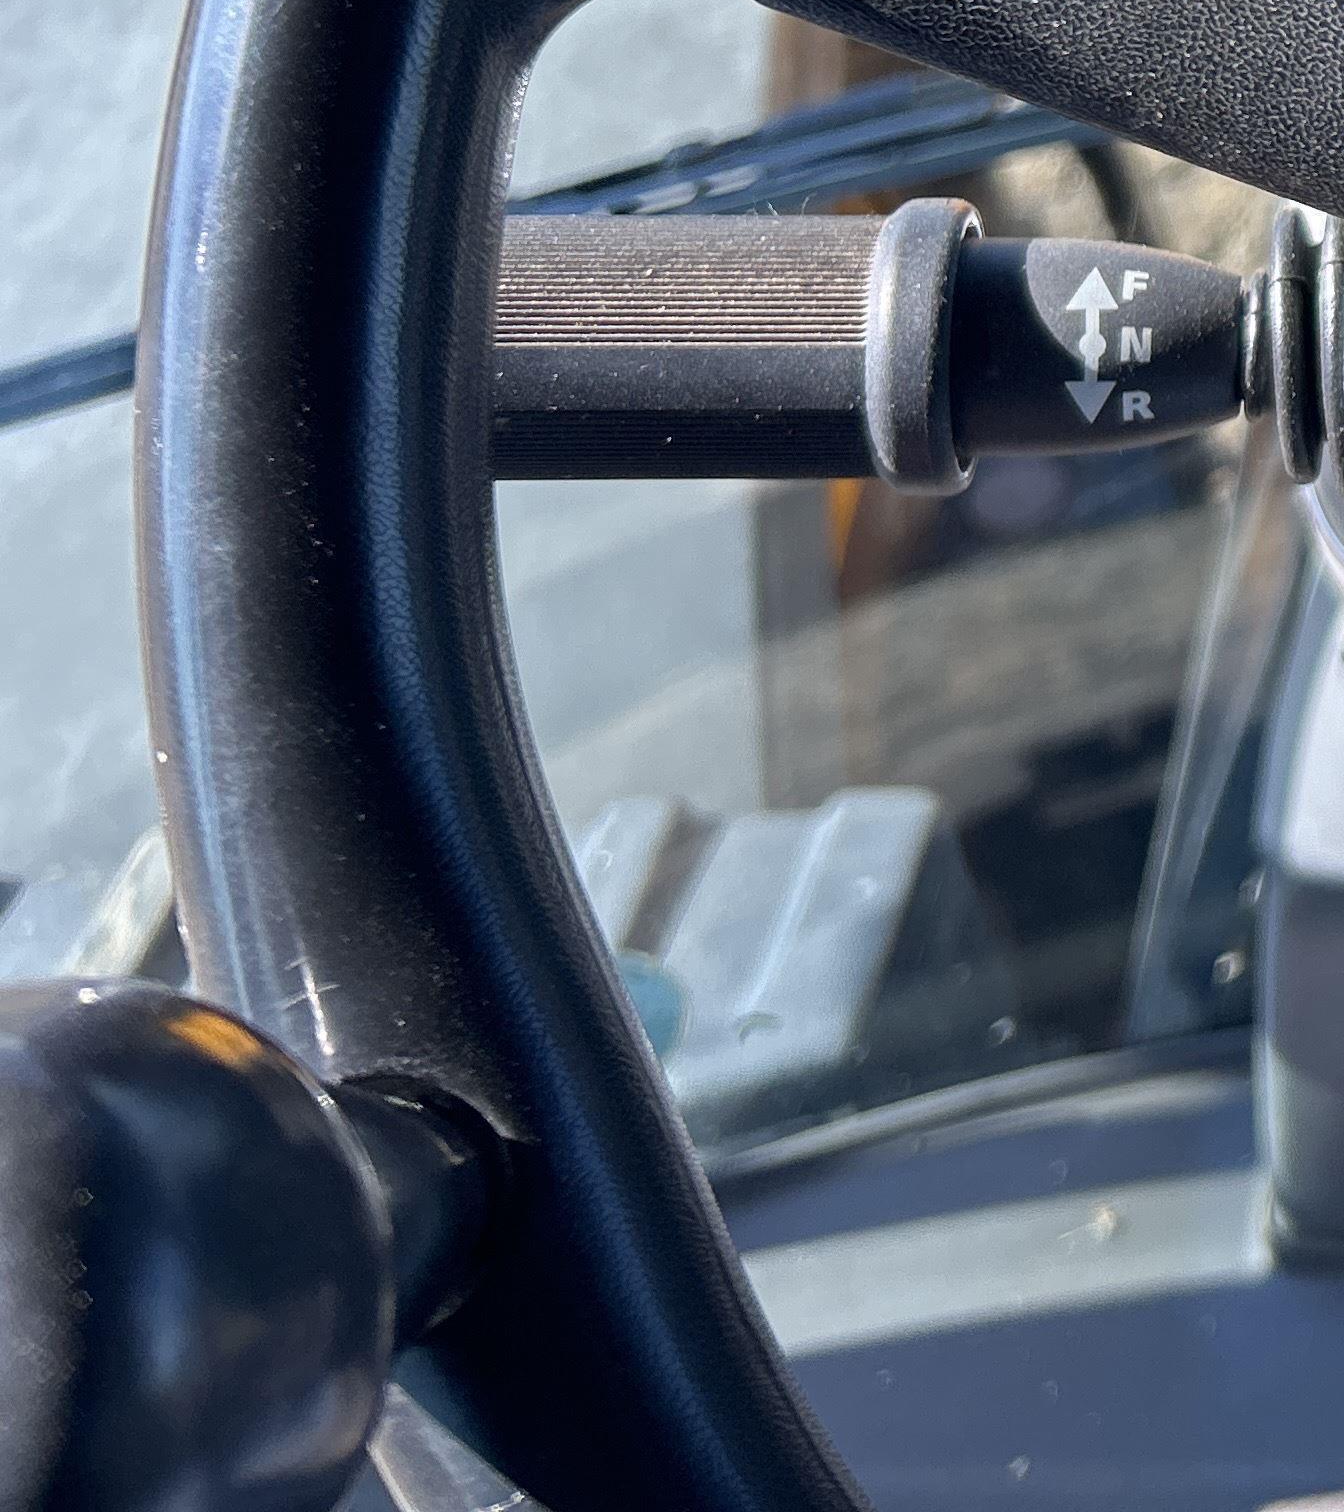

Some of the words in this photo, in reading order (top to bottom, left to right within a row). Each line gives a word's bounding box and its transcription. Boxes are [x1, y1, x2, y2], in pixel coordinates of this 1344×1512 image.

[1121, 269, 1150, 301] F
[1120, 326, 1152, 363] N
[1122, 390, 1155, 422] R
